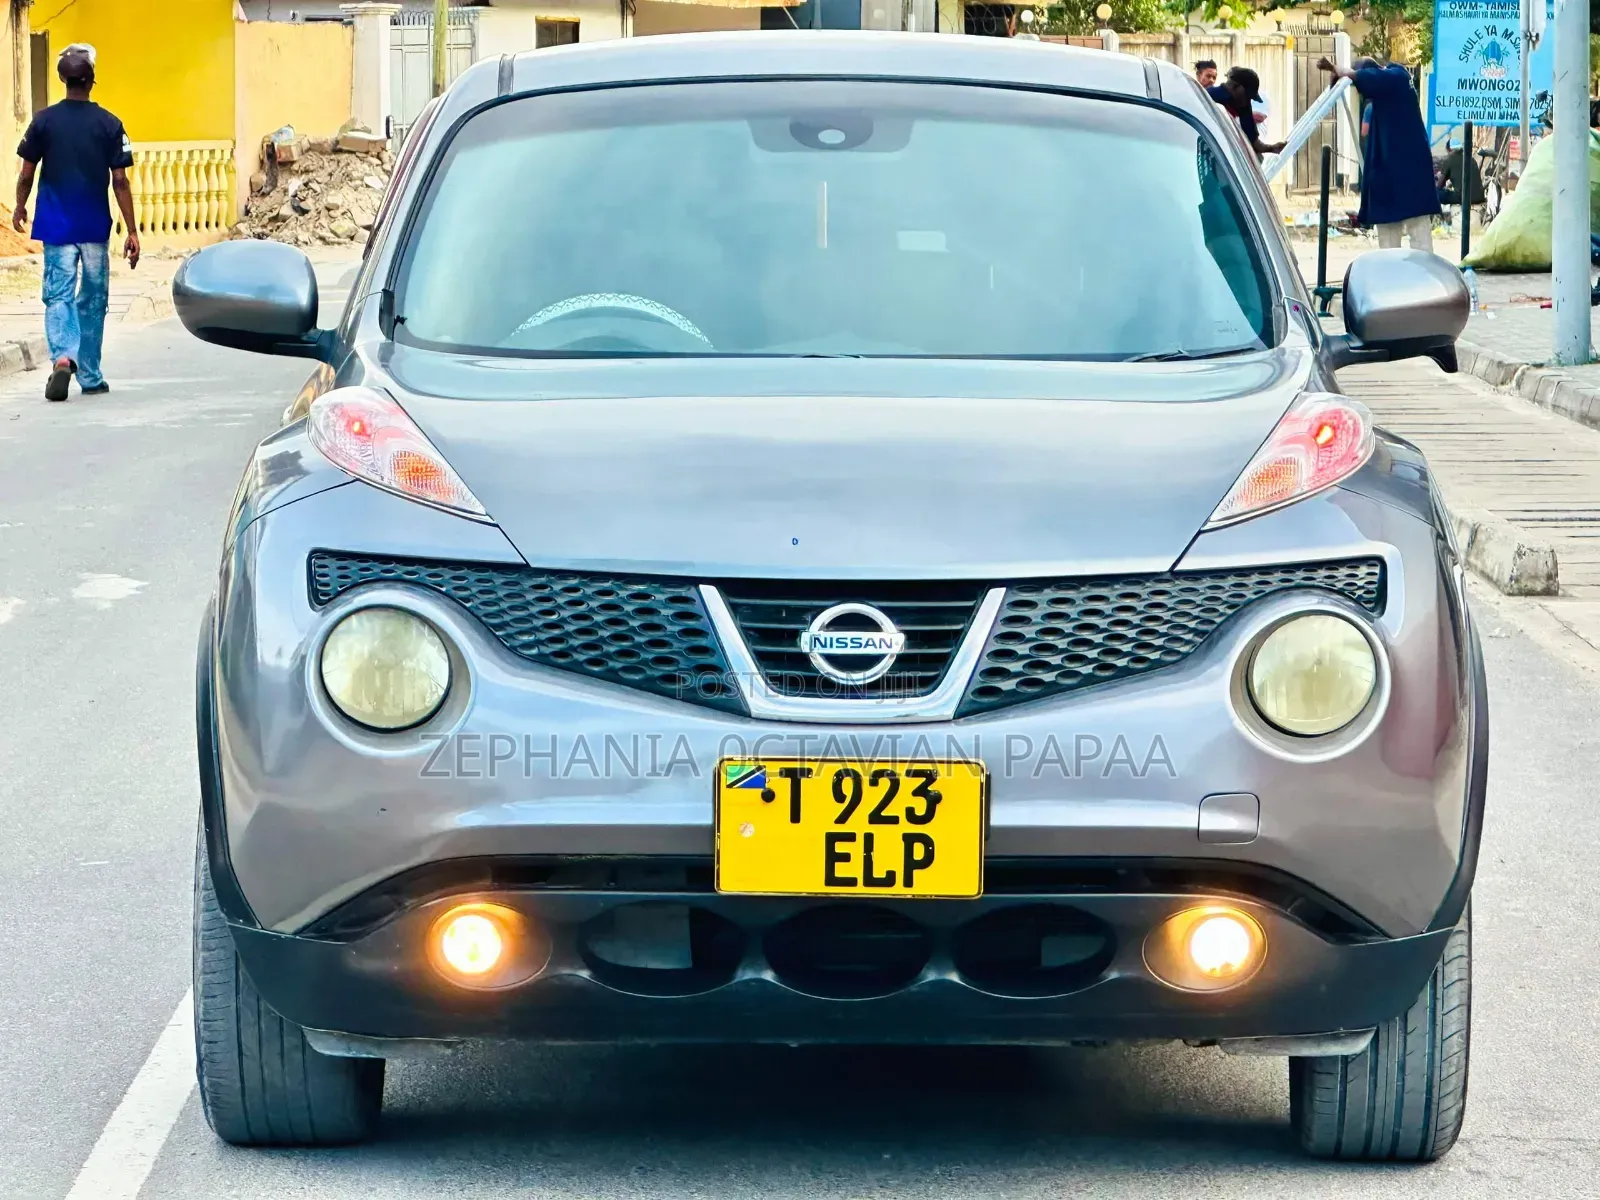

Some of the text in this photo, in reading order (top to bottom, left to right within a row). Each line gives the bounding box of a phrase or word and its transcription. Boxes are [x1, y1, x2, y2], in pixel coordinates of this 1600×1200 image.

[1458, 29, 1484, 64] SHULE
[1484, 24, 1498, 37] YA
[1457, 78, 1532, 92] MWONGOZ
[1457, 110, 1485, 120] ELIMU
[1487, 111, 1497, 120] NI
[813, 636, 893, 649] NISSAN
[778, 767, 941, 825] T 923
[824, 831, 936, 888] ELP
